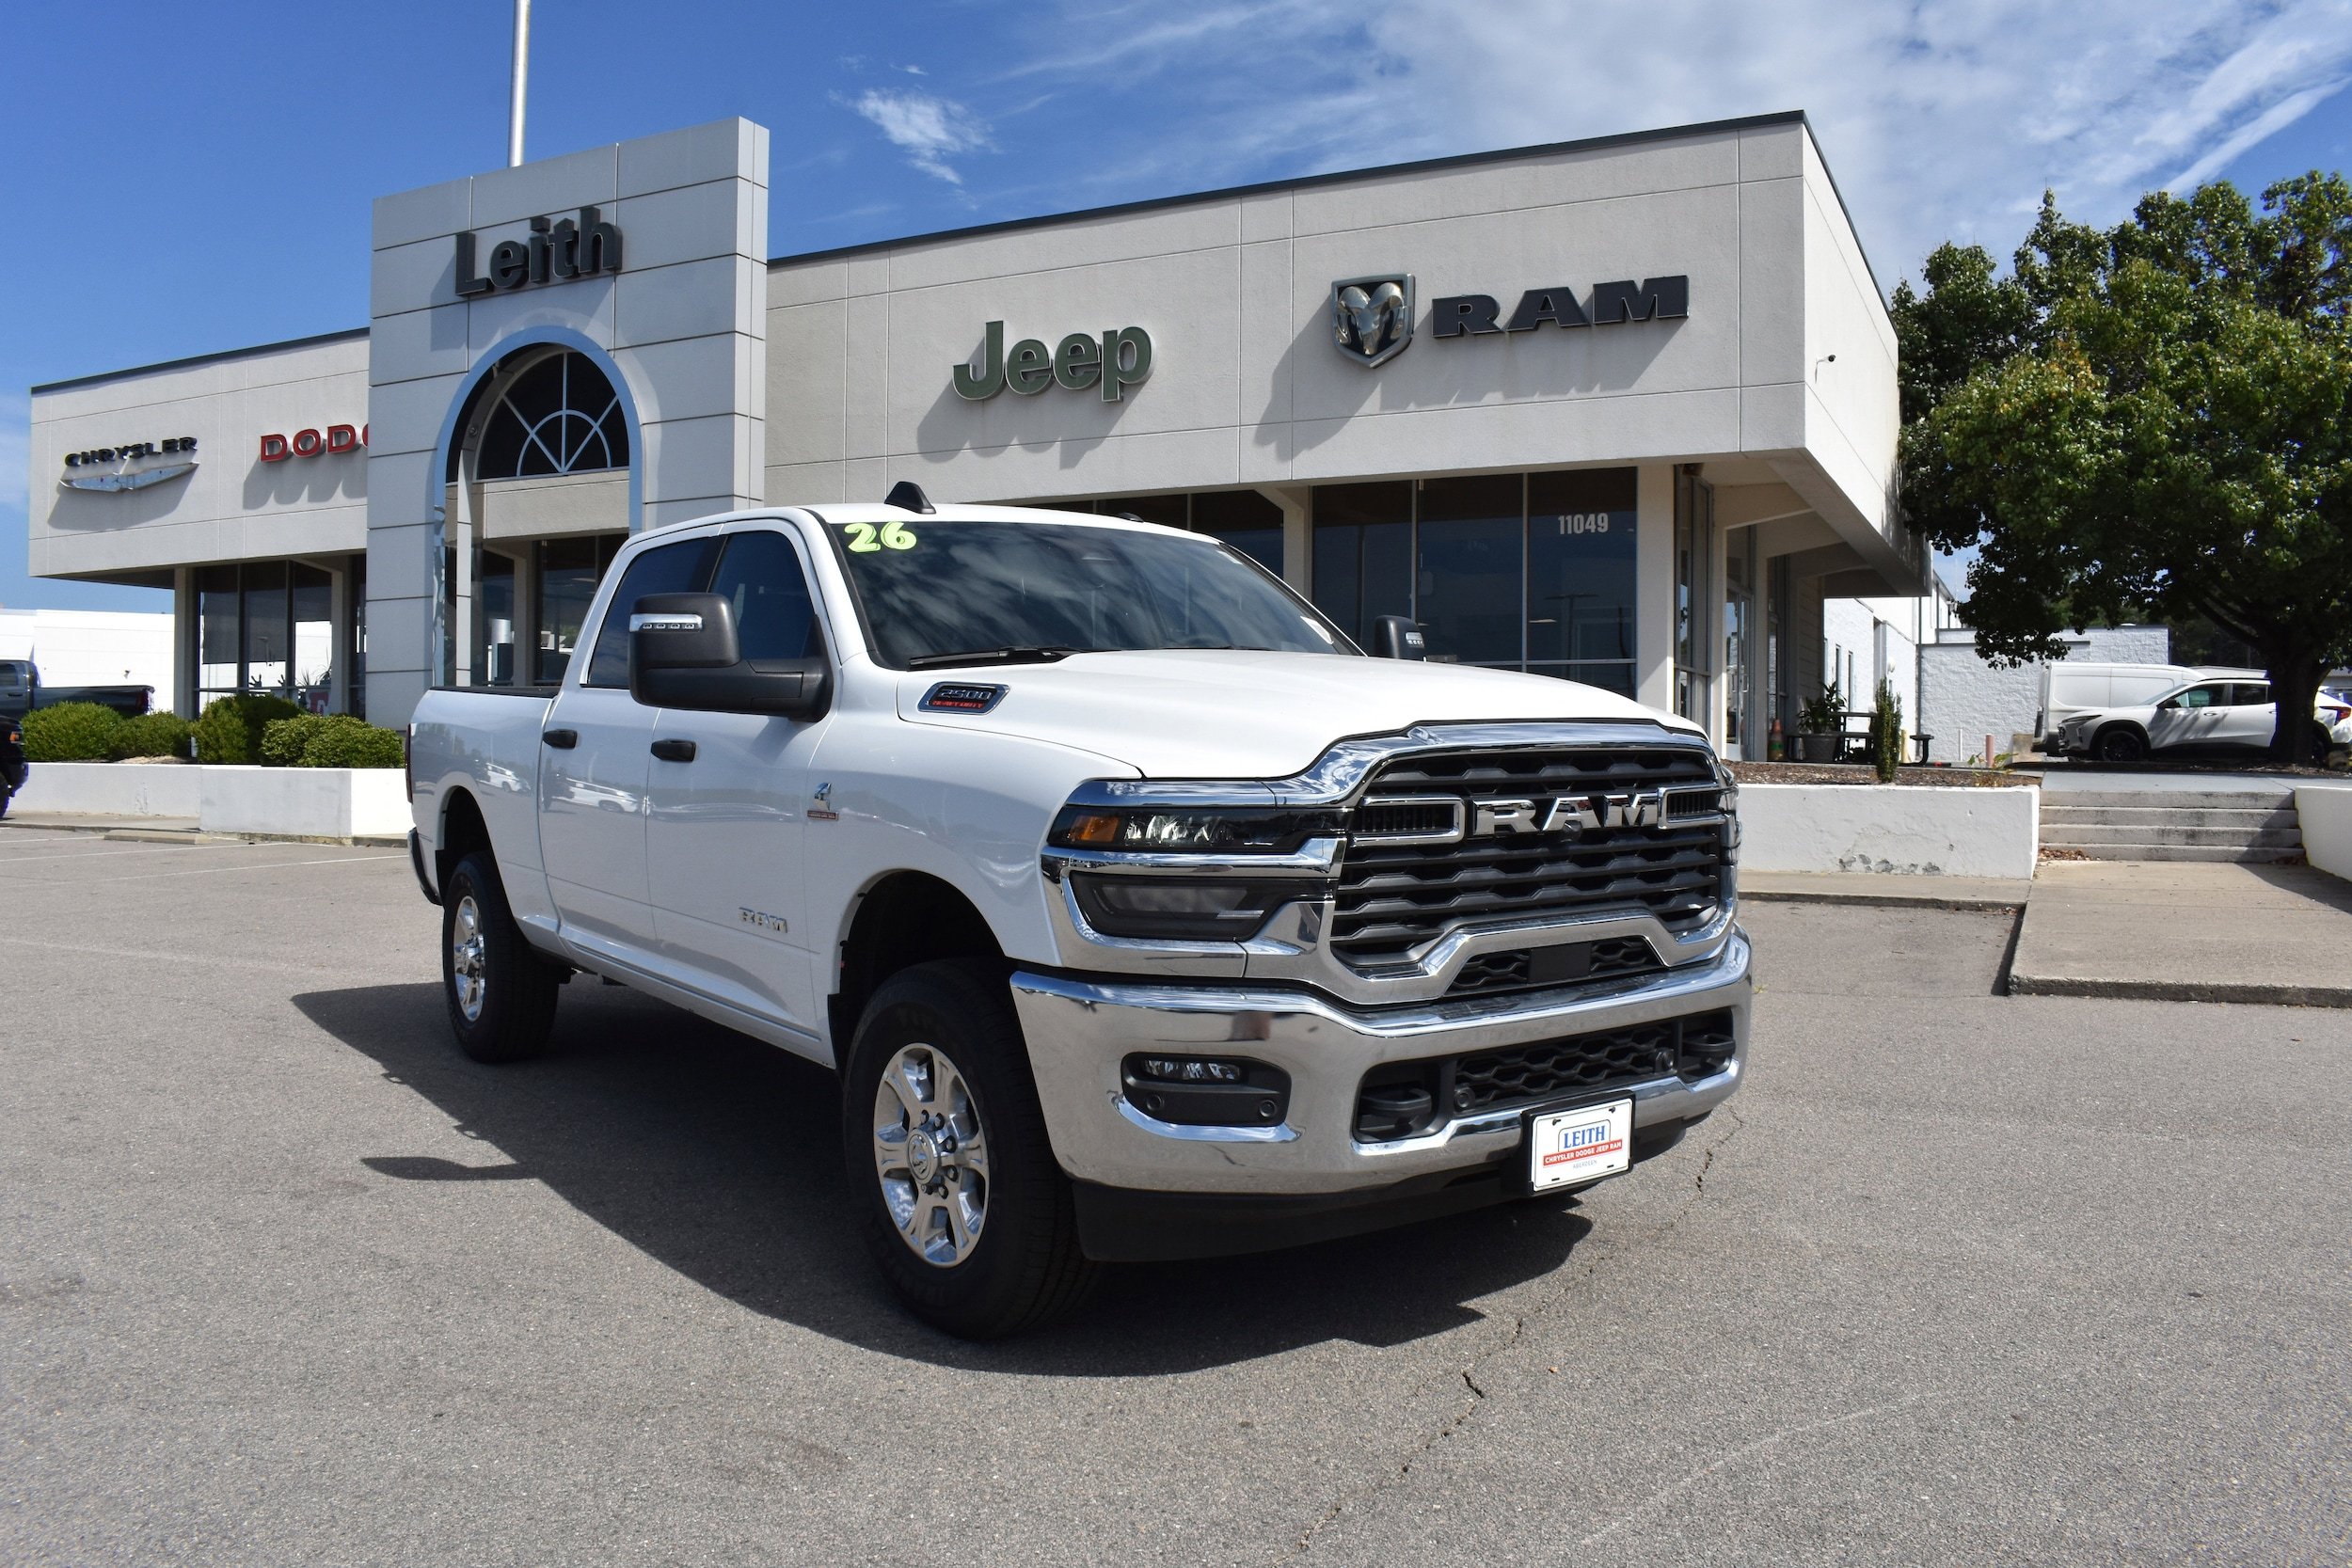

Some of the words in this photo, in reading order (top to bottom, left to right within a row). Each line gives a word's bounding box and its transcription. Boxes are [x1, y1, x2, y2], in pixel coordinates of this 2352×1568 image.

[455, 206, 623, 295] Leith
[1432, 276, 1689, 338] RAM
[952, 321, 1155, 403] Jeep
[65, 436, 198, 467] CHRYSLER
[261, 423, 369, 462] DOD
[844, 521, 917, 553] 26
[1558, 513, 1609, 534] 11049
[941, 689, 993, 700] 2500
[1472, 793, 1659, 835] RAM
[739, 907, 787, 933] RAM
[1564, 1125, 1606, 1148] LEITH
[1545, 1151, 1575, 1164] CHRYSLER
[1575, 1147, 1595, 1158] DODGE
[1596, 1144, 1609, 1153] JEEP
[1610, 1141, 1622, 1150] RAM
